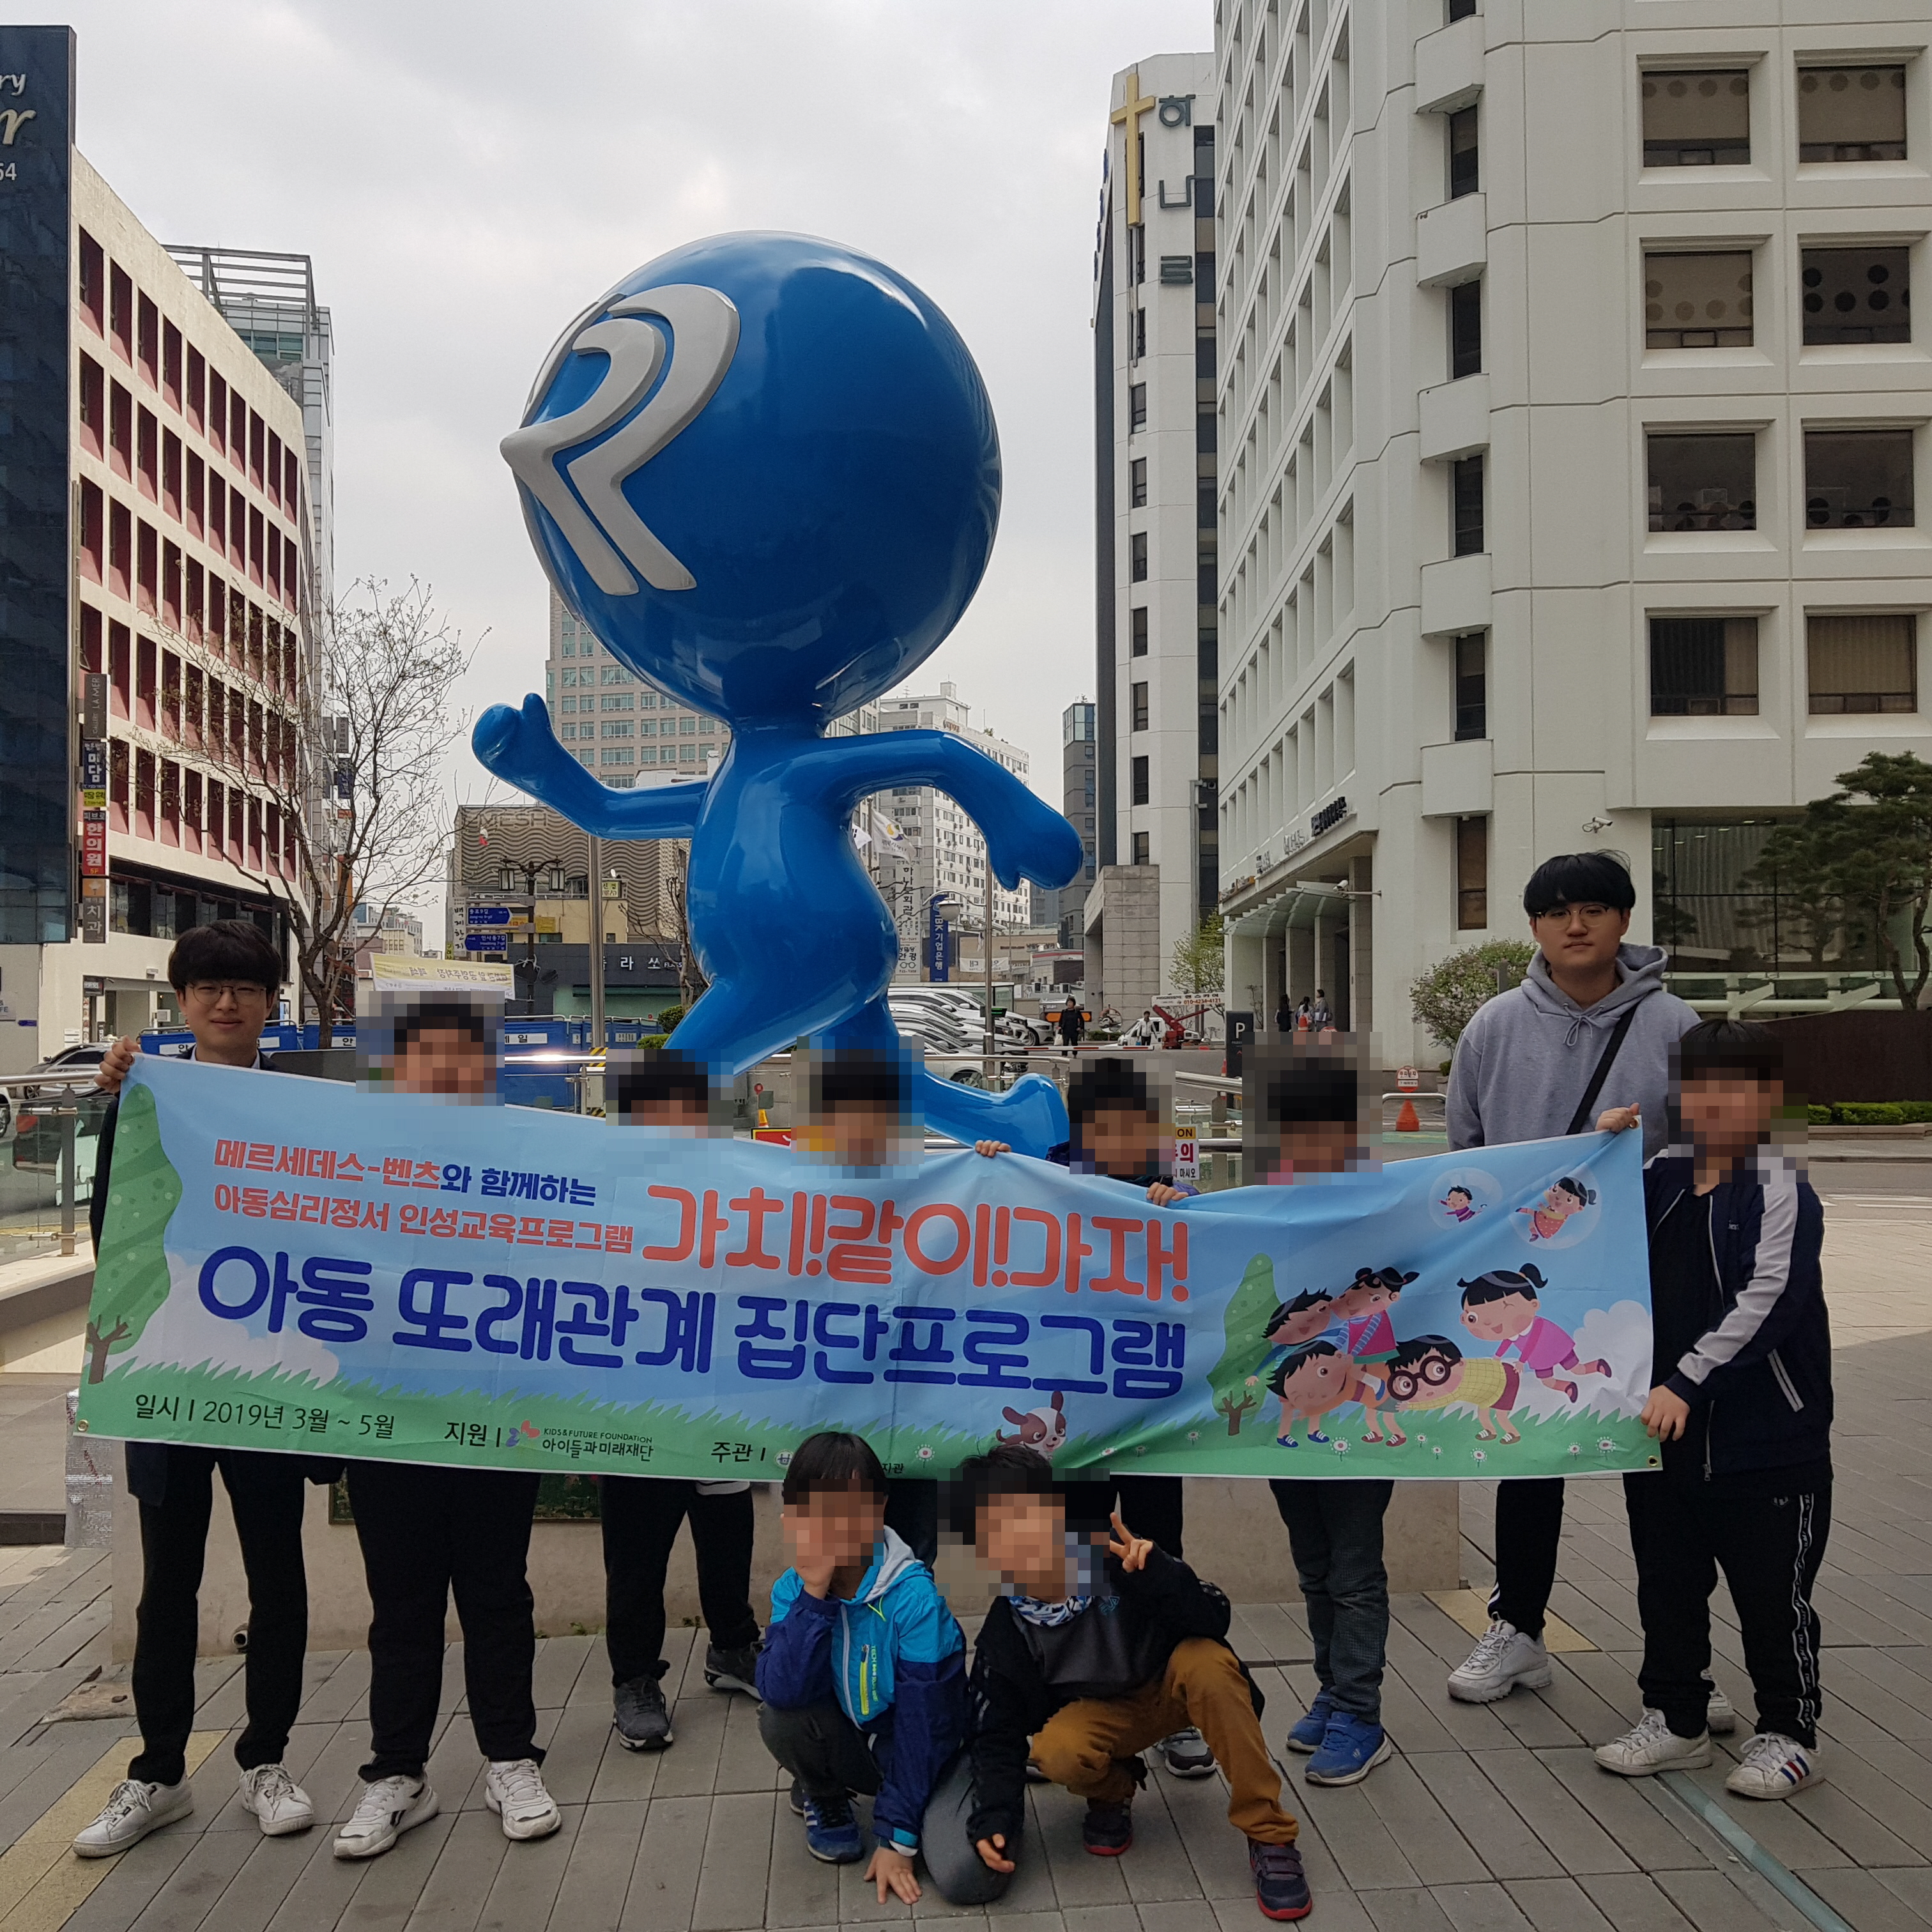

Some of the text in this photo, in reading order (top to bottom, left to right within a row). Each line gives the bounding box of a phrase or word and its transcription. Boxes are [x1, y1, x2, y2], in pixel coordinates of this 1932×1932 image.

[86, 823, 103, 867] 한의원
[86, 905, 102, 934] 치과
[1235, 1022, 1245, 1039] P
[1176, 1128, 1193, 1137] ON
[214, 1139, 596, 1206] 메르세데스-벤츠와 함께하는
[1179, 1168, 1195, 1178] 마시오
[214, 1184, 634, 1254] 아동심리정서 인성교육프로그램
[198, 1246, 1186, 1399] 아동 또래관계 집단프로그램
[135, 1394, 180, 1422] 일시
[203, 1401, 284, 1430] 2019년
[292, 1408, 330, 1434] 3월
[358, 1414, 394, 1439] 5월
[445, 1422, 487, 1446] 지원
[600, 1432, 652, 1444] FOUNDATION
[710, 1442, 753, 1463] 주관
